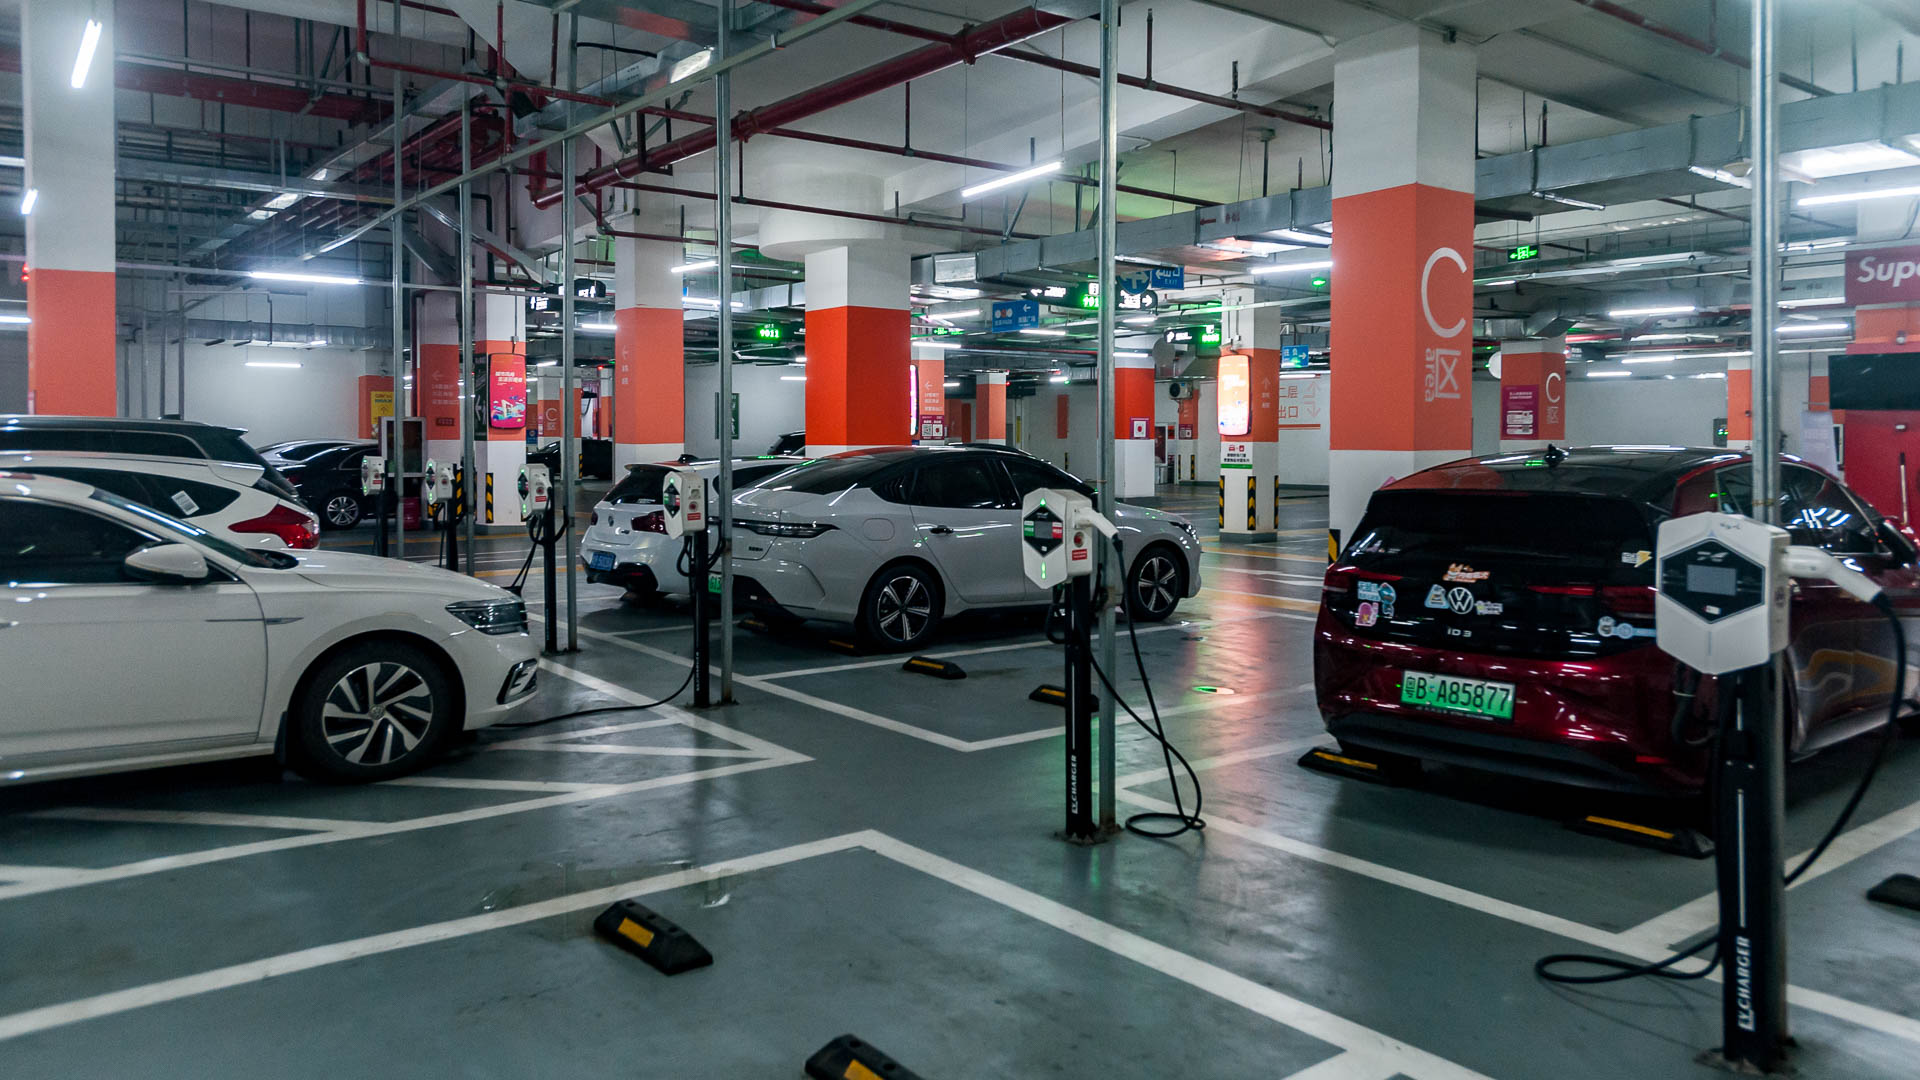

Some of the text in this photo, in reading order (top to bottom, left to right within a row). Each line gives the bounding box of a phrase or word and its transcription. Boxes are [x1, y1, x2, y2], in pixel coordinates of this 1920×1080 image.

[1857, 256, 1920, 287] Sup
[1421, 247, 1467, 338] C
[1424, 348, 1436, 402] area
[1434, 348, 1462, 399] 区
[1545, 372, 1561, 403] C
[545, 407, 558, 422] C
